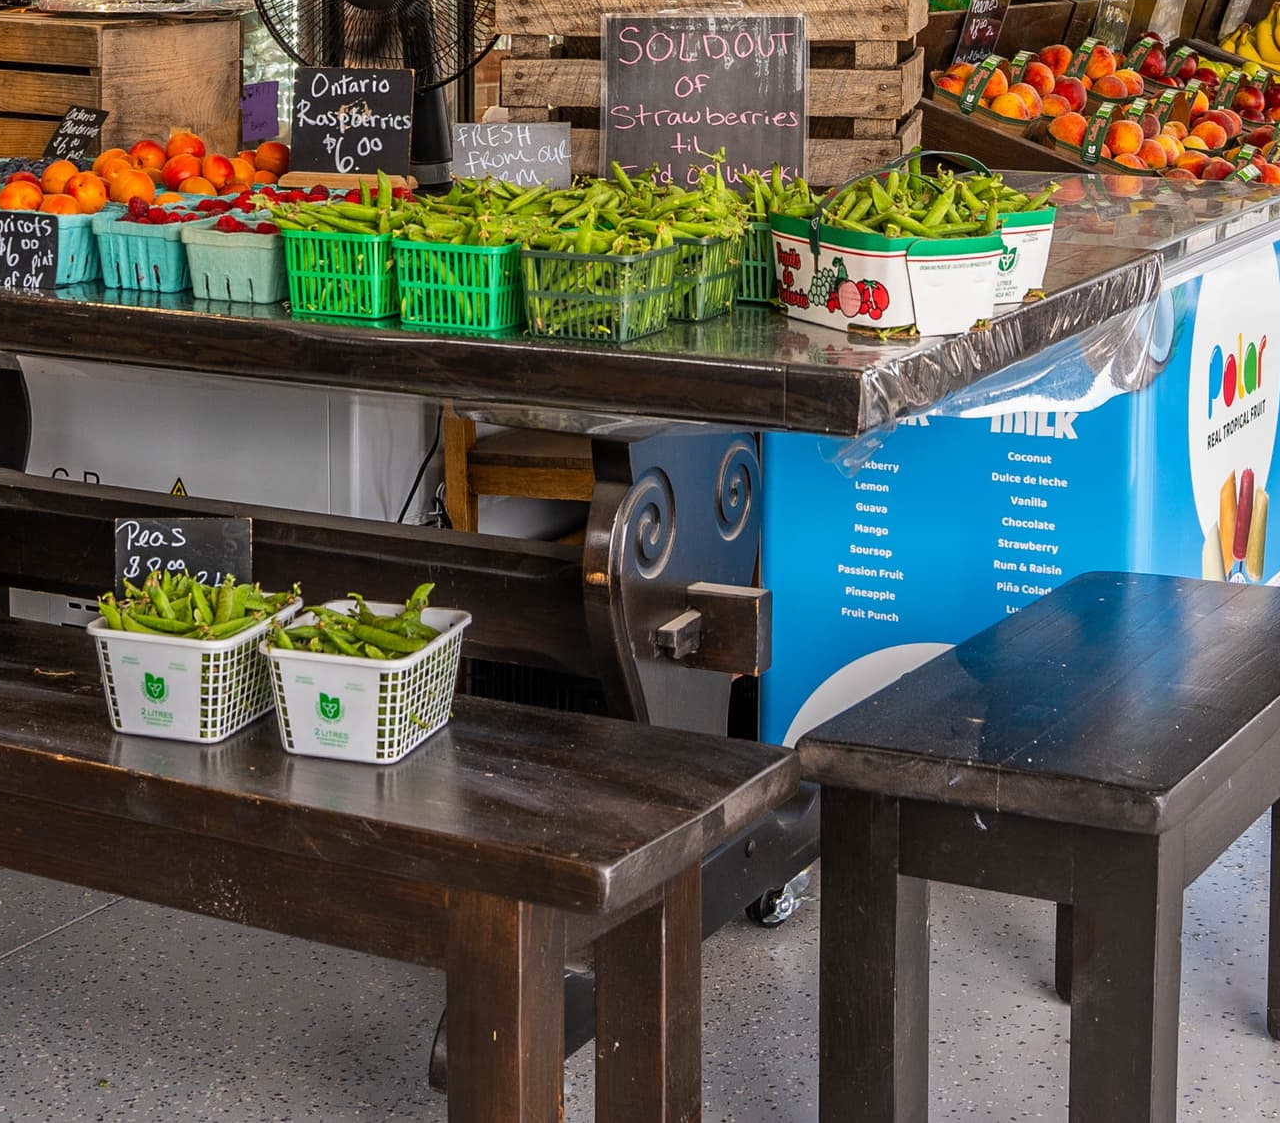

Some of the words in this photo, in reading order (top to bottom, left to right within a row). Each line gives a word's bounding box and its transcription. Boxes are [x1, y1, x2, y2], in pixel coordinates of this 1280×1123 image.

[311, 72, 391, 99] Ontario
[296, 98, 412, 134] Raspberries
[609, 104, 800, 130] Strawberries
[456, 123, 533, 150] FRESH
[670, 132, 702, 155] til
[322, 133, 383, 174] $6.00
[537, 141, 572, 167] OUR
[32, 249, 54, 275] pint
[4, 271, 20, 287] of
[23, 272, 45, 288] ON
[1207, 332, 1268, 420] polar
[1207, 427, 1222, 451] REAL
[1223, 409, 1250, 440] TROPICAL
[1250, 398, 1266, 422] FRUIT
[1007, 451, 1053, 465] Coconut
[855, 480, 890, 493] Lemon
[991, 471, 1022, 485] Dulce
[1023, 475, 1038, 485] de
[1038, 476, 1069, 488] leche
[855, 502, 888, 514] Guava
[1010, 495, 1049, 508] Vanilla
[854, 523, 889, 537] Mango
[1001, 516, 1057, 532] Chocolate
[116, 520, 187, 551] Peas
[849, 544, 893, 559] Soursop
[997, 538, 1060, 555] Strawberry
[838, 564, 878, 578] Passion
[879, 569, 904, 581] Fruit
[993, 559, 1018, 571] Rum
[1019, 562, 1028, 572] &
[1029, 563, 1063, 577] Raisin
[845, 586, 896, 602] Pineapple
[996, 581, 1020, 593] Piña
[841, 607, 866, 619] Fruit
[867, 610, 899, 623] Punch
